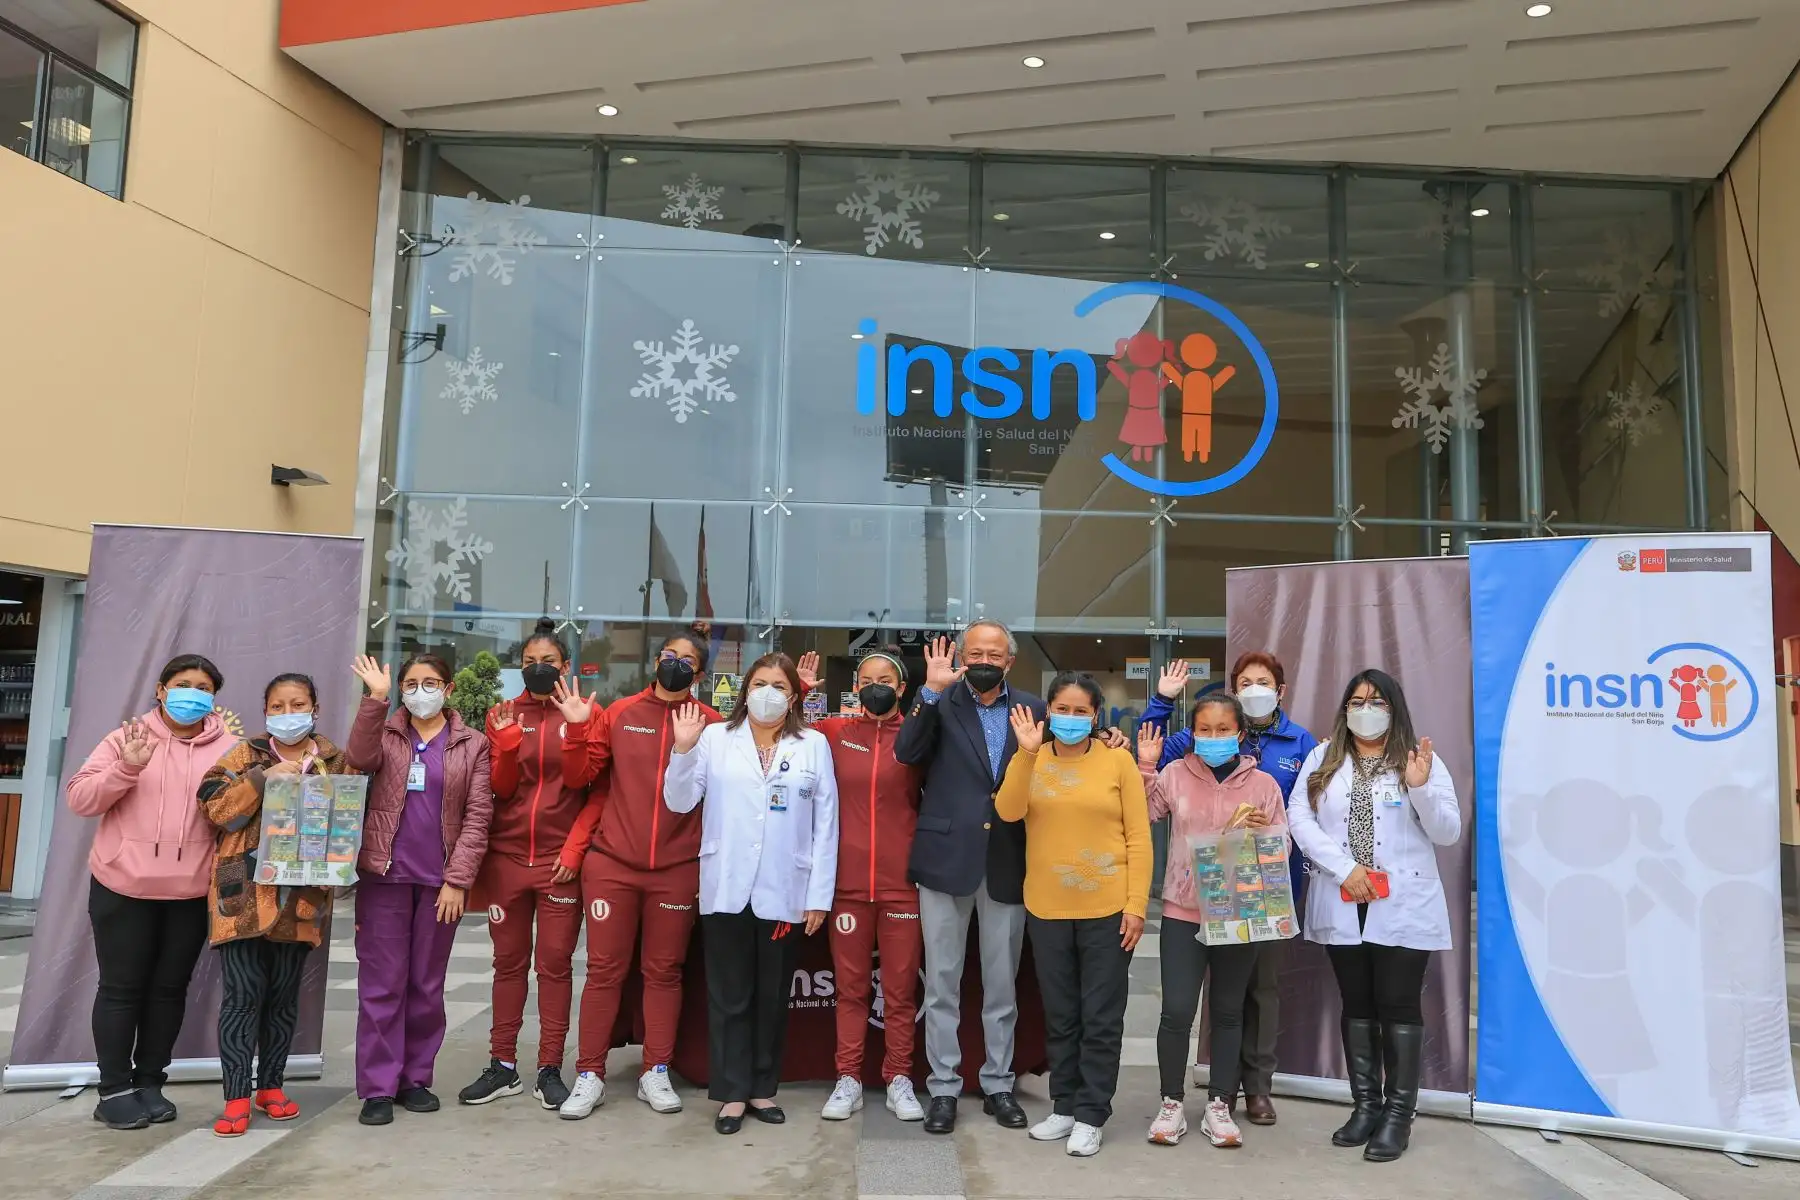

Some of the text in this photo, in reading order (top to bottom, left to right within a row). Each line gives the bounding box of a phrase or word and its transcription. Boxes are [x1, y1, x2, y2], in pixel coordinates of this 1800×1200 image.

[856, 317, 1098, 421] insn
[996, 427, 1035, 440] Salud
[1038, 428, 1060, 440] del
[1028, 443, 1055, 456] San
[1642, 554, 1664, 565] PERÚ
[1670, 556, 1703, 564] Ministerio
[1714, 556, 1732, 564] Salud
[1545, 662, 1664, 708] insn
[1646, 718, 1665, 727] Borja
[623, 724, 656, 735] marathon
[840, 739, 870, 753] marathon
[547, 894, 578, 904] marathon
[886, 912, 919, 920] marathon
[839, 916, 852, 932] U
[790, 969, 835, 998] ns
